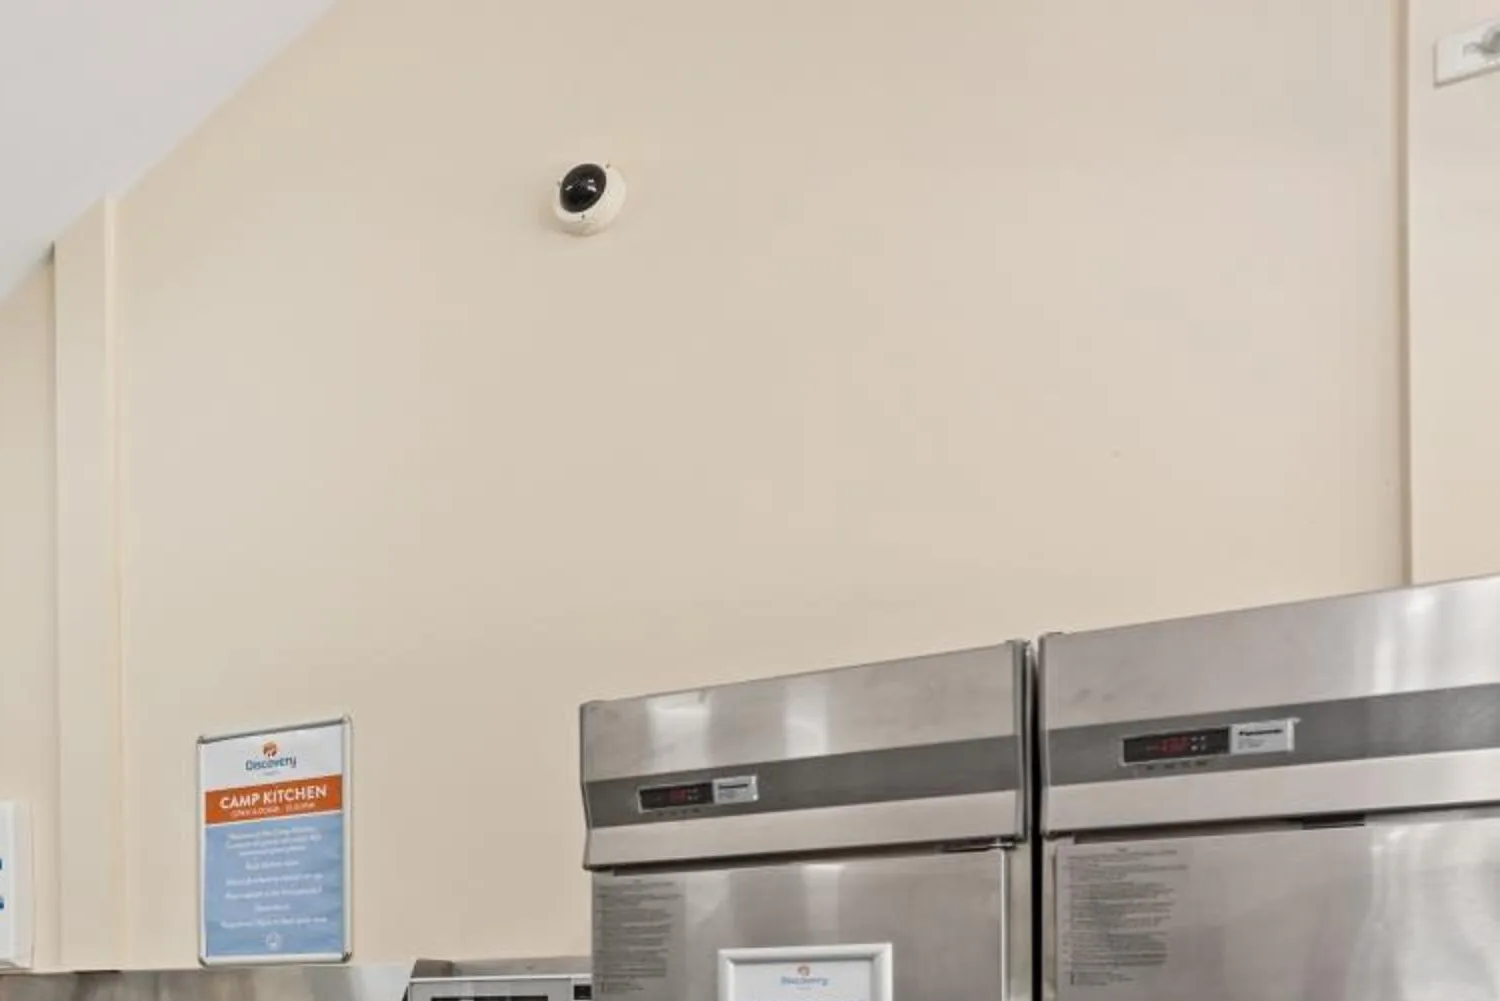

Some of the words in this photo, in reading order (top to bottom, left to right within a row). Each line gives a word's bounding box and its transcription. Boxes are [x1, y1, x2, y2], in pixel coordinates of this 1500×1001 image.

[245, 756, 297, 771] Discovery
[220, 793, 260, 809] CAMP
[263, 785, 327, 804] KITCHEN
